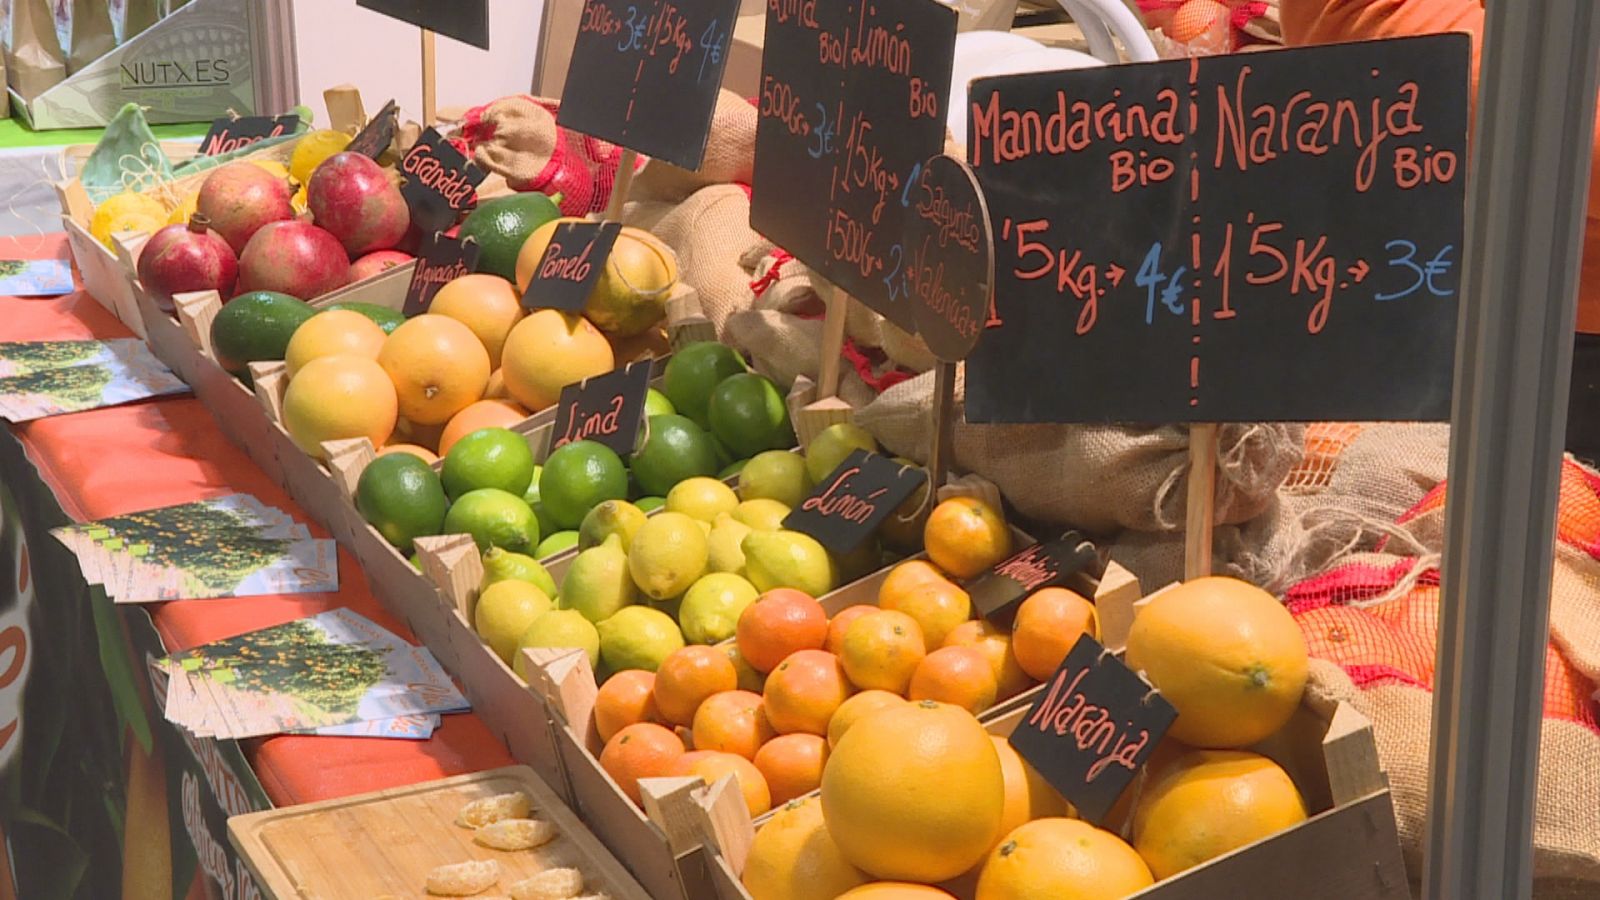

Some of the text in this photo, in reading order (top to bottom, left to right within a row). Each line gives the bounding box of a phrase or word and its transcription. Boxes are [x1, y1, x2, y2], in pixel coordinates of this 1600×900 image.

[120, 59, 230, 85] NUTXES
[818, 31, 842, 65] Bio
[909, 77, 937, 118] Bio
[972, 87, 1185, 167] Mandarina
[1214, 65, 1424, 193] Naranja
[402, 144, 472, 209] Granada
[1108, 148, 1175, 193] Bio
[1393, 144, 1457, 189] Bio
[540, 240, 595, 283] Pomelo
[1135, 242, 1187, 325] 4€
[1374, 240, 1455, 302] 3€
[554, 393, 624, 449] Lima
[801, 466, 887, 526] Limón
[1029, 666, 1150, 783] Naranja
